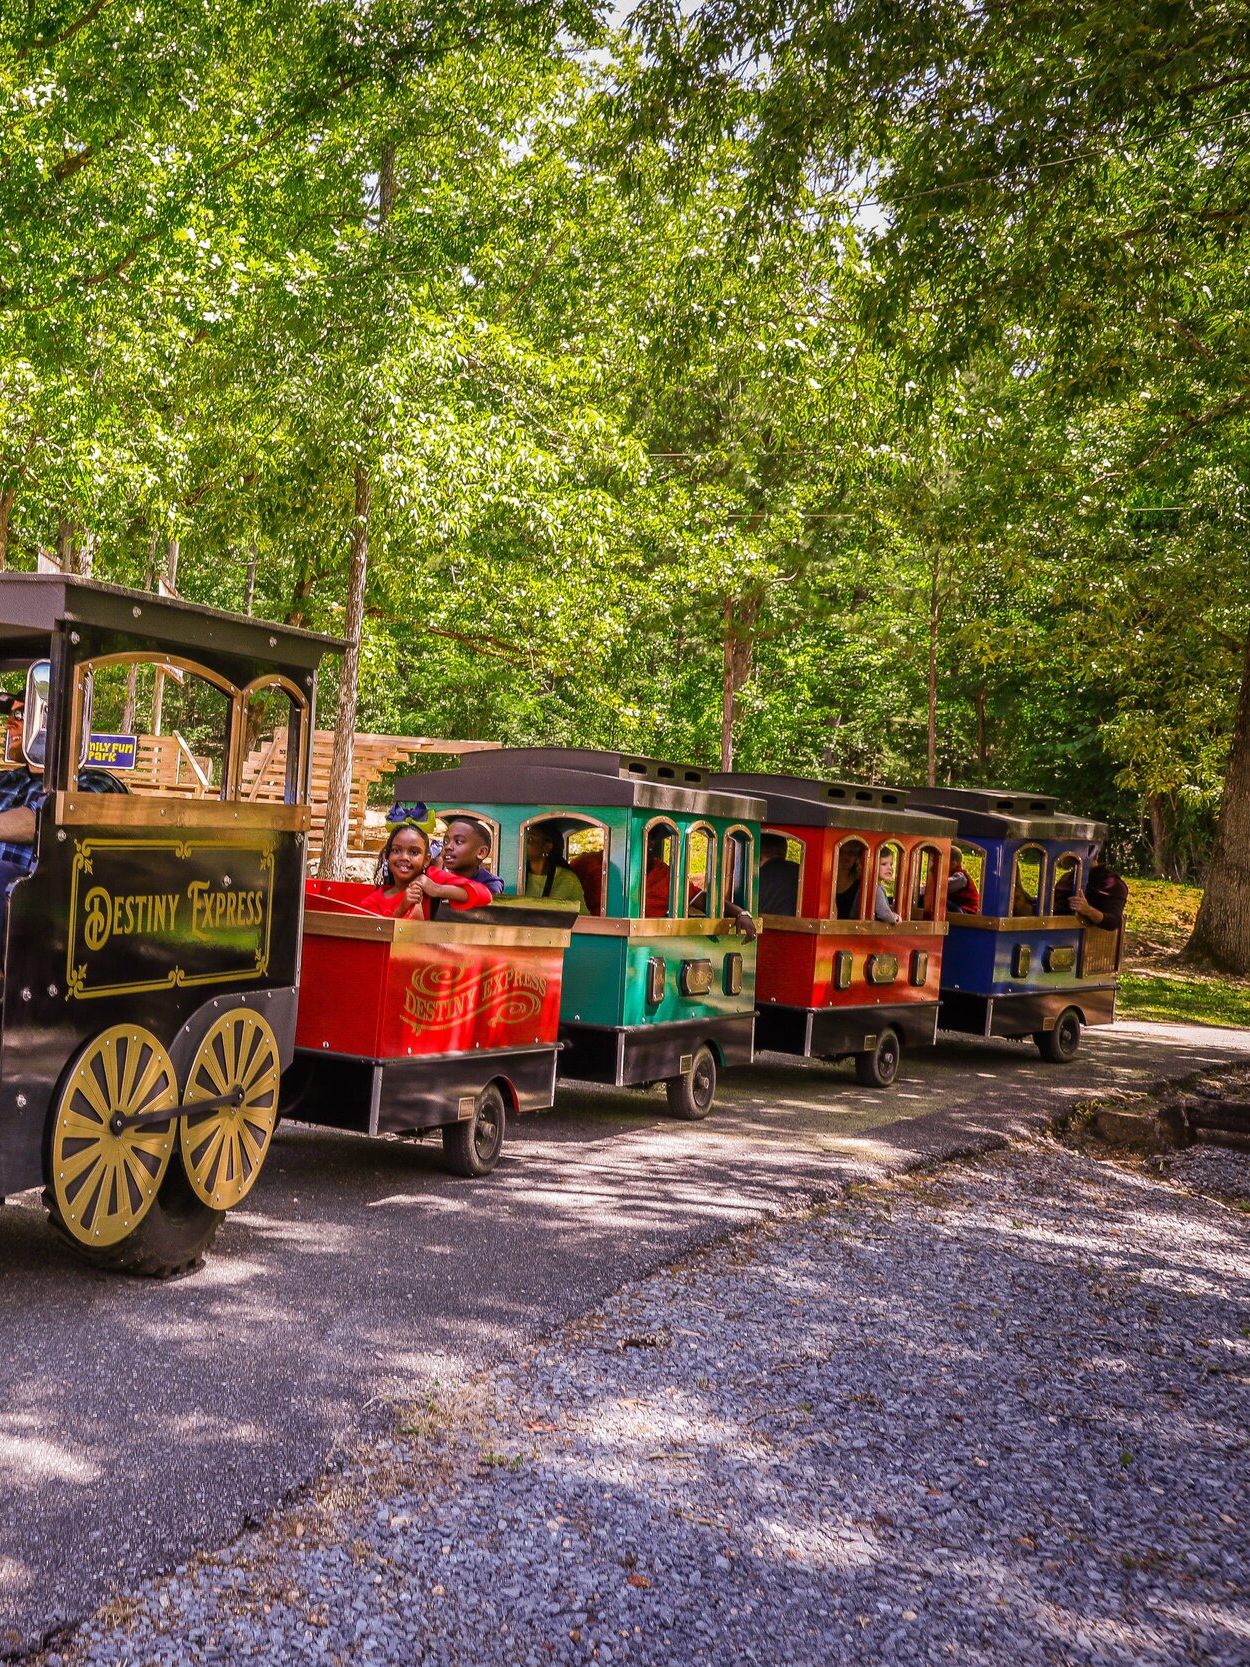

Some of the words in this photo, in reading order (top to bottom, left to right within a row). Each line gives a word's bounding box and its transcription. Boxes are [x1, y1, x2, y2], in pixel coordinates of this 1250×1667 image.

[84, 886, 180, 951] DESTINY
[187, 880, 263, 941] EXPRESS
[404, 987, 477, 1022] DESTINY
[482, 967, 547, 1001] EXPRESS
